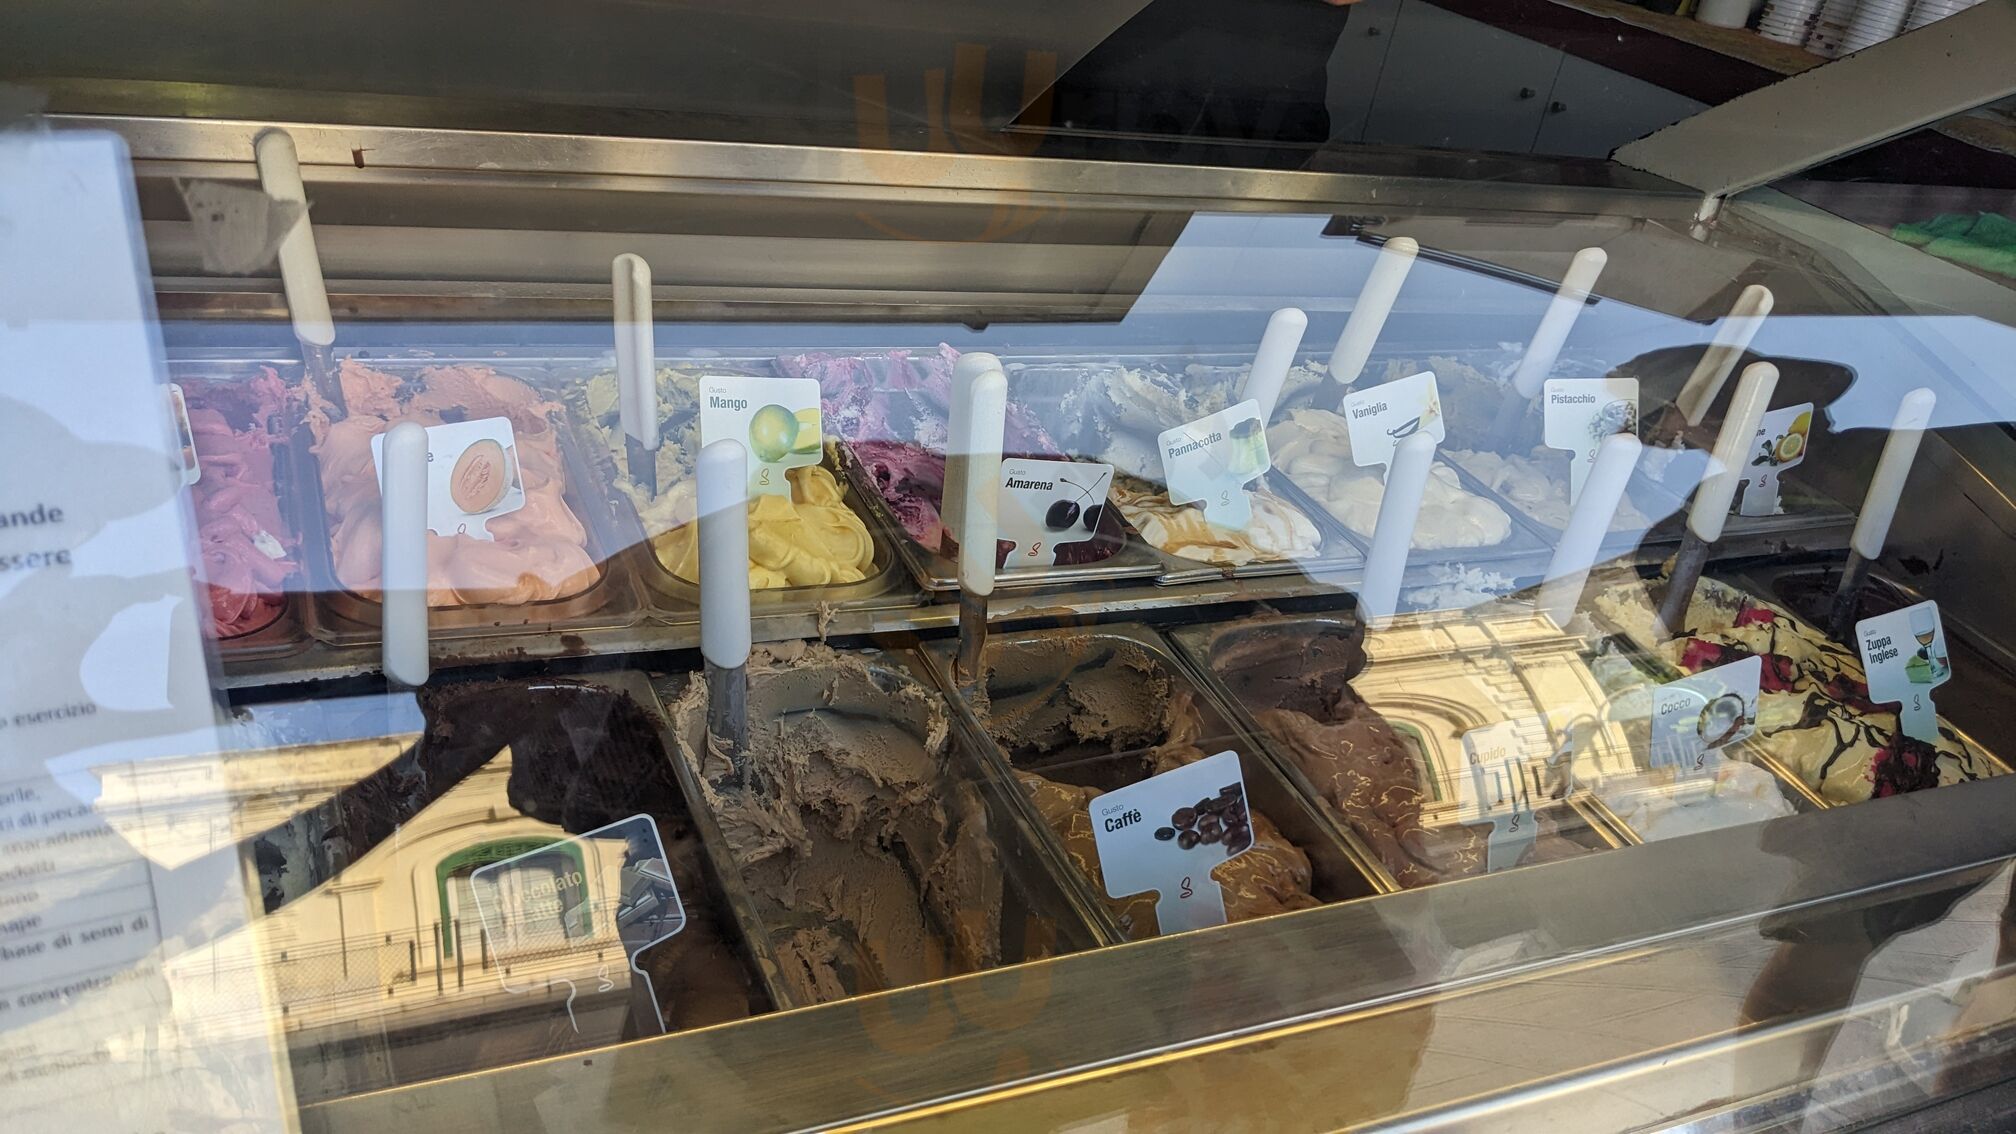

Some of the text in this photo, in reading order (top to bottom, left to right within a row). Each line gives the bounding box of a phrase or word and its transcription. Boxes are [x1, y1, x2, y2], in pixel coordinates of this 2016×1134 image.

[709, 386, 727, 394] Gusto
[709, 396, 748, 411] Mango
[1551, 394, 1596, 404] Pistacchio
[1352, 401, 1388, 419] Vaniglia
[1168, 431, 1222, 459] Pannacotta
[1009, 468, 1026, 476] Gusto
[1005, 477, 1054, 491] Amarena
[1866, 635, 1892, 651] Zuppa
[1868, 646, 1899, 664] Inglese
[14, 701, 97, 727] esercizio
[1660, 697, 1691, 716] Cocco
[1101, 803, 1125, 817] Gusto
[1104, 808, 1142, 833] Caffè
